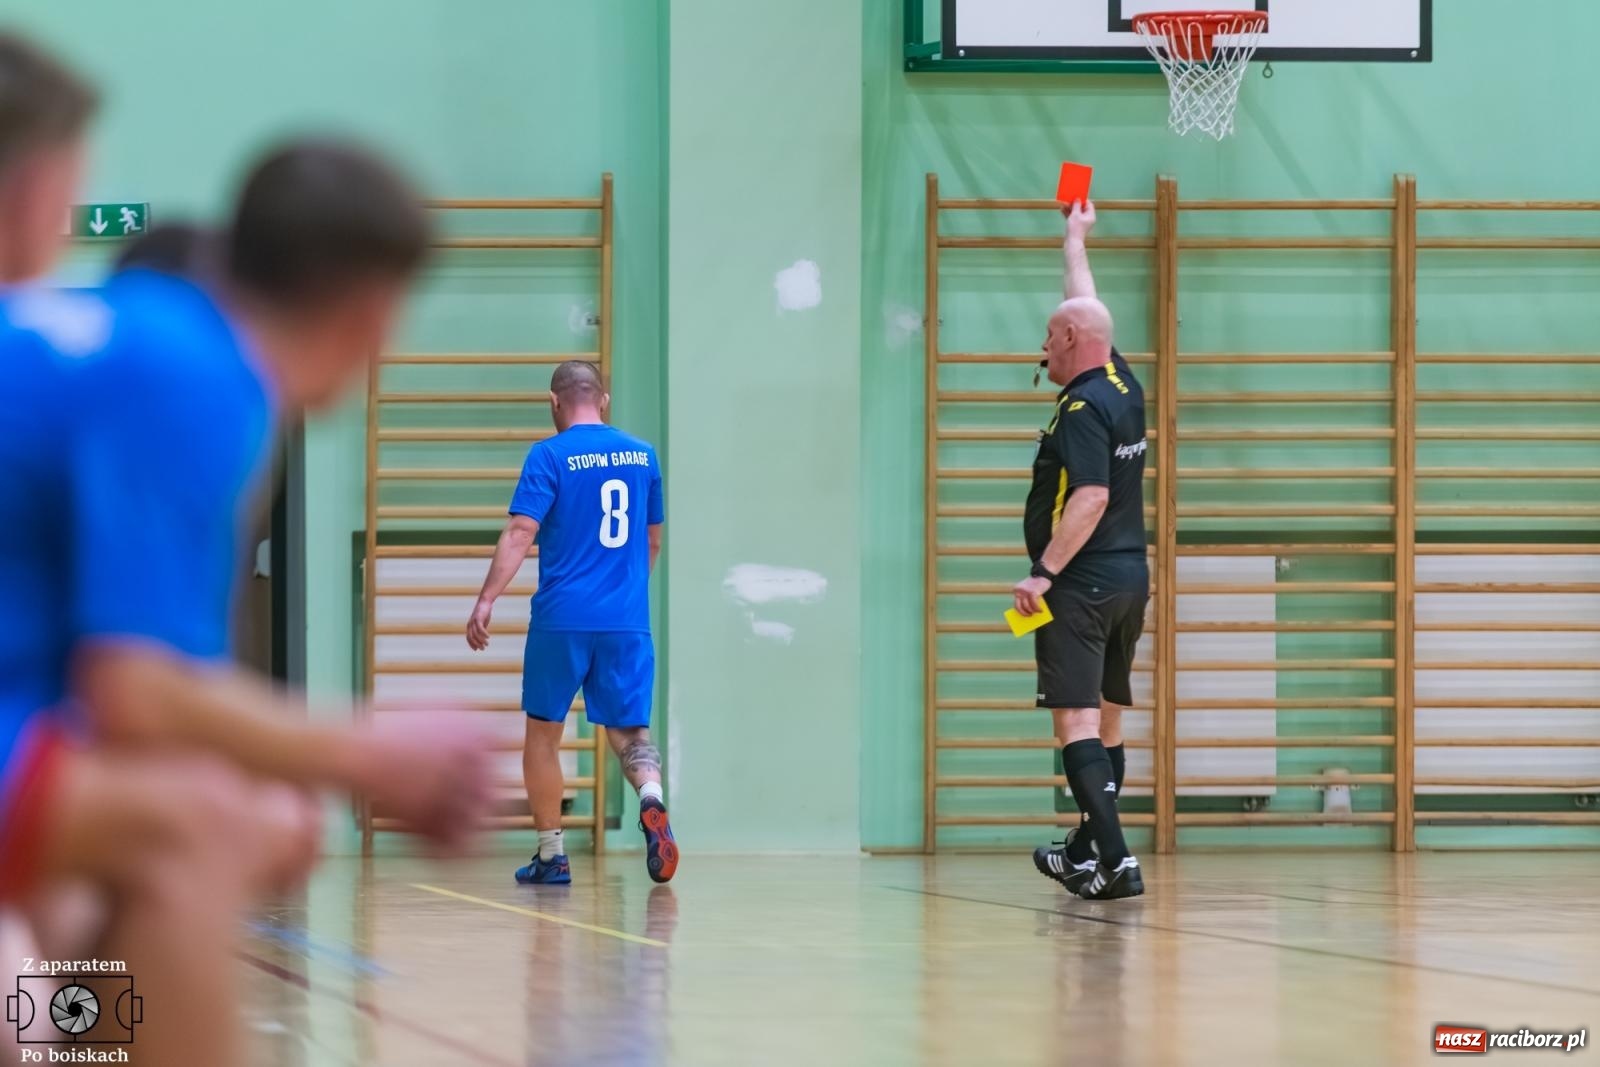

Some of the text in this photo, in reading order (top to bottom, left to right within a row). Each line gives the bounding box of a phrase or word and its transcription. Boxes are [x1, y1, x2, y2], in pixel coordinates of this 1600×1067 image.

[567, 450, 650, 471] STOPIW GARAGE
[599, 478, 629, 549] 8
